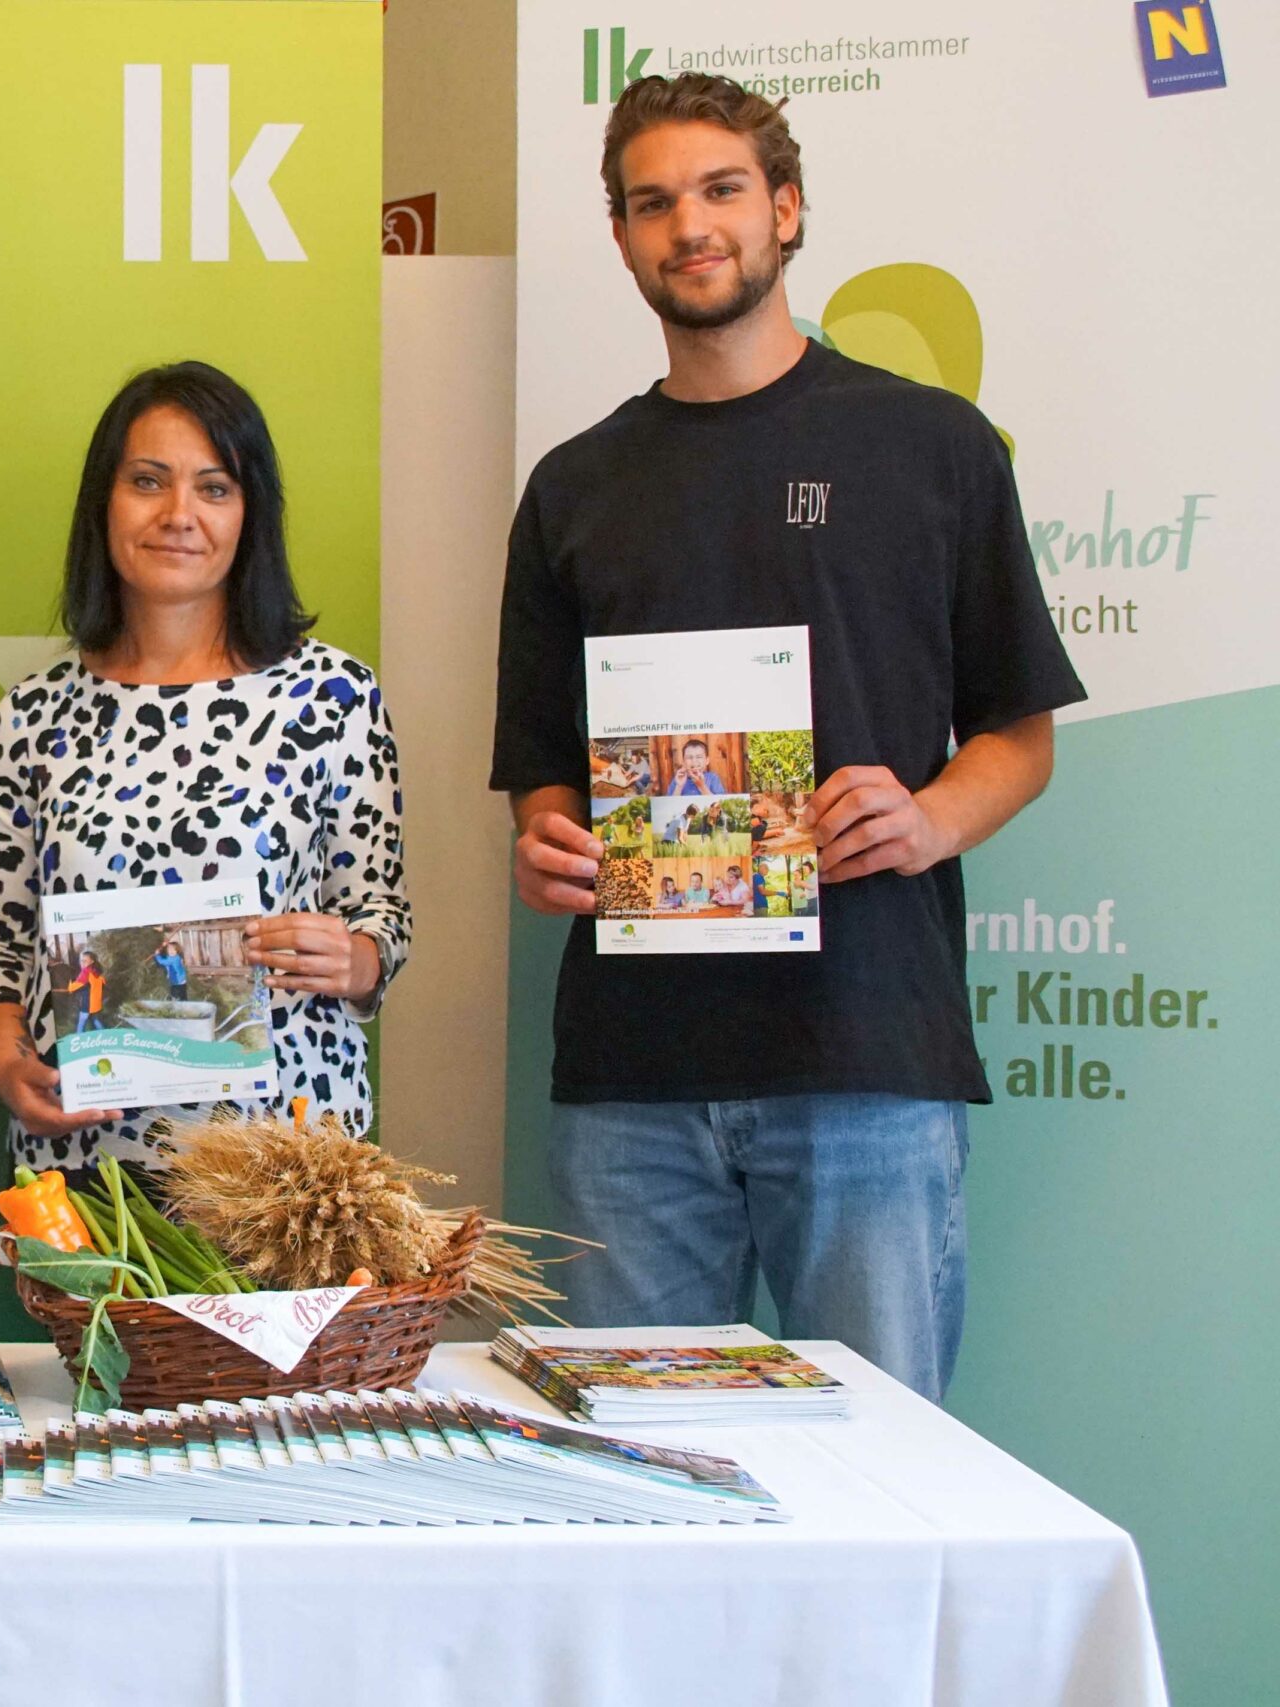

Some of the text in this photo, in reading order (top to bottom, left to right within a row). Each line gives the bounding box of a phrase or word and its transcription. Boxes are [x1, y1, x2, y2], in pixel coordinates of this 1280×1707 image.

[667, 36, 970, 70] Landwirtschaftskammer
[1148, 7, 1209, 61] N
[583, 27, 654, 104] lk
[742, 67, 880, 96] rösterreich
[123, 64, 309, 262] lk
[786, 482, 831, 524] LFDY
[671, 723, 681, 731] für
[683, 723, 697, 731] uns
[699, 722, 714, 730] alle
[966, 898, 1127, 954] rnhof.
[1017, 971, 1218, 1029] Kinder.
[70, 1035, 118, 1053] Erlebnis
[122, 1033, 183, 1058] Bauernhof
[1006, 1044, 1126, 1100] alle.
[186, 1294, 267, 1334] Brot
